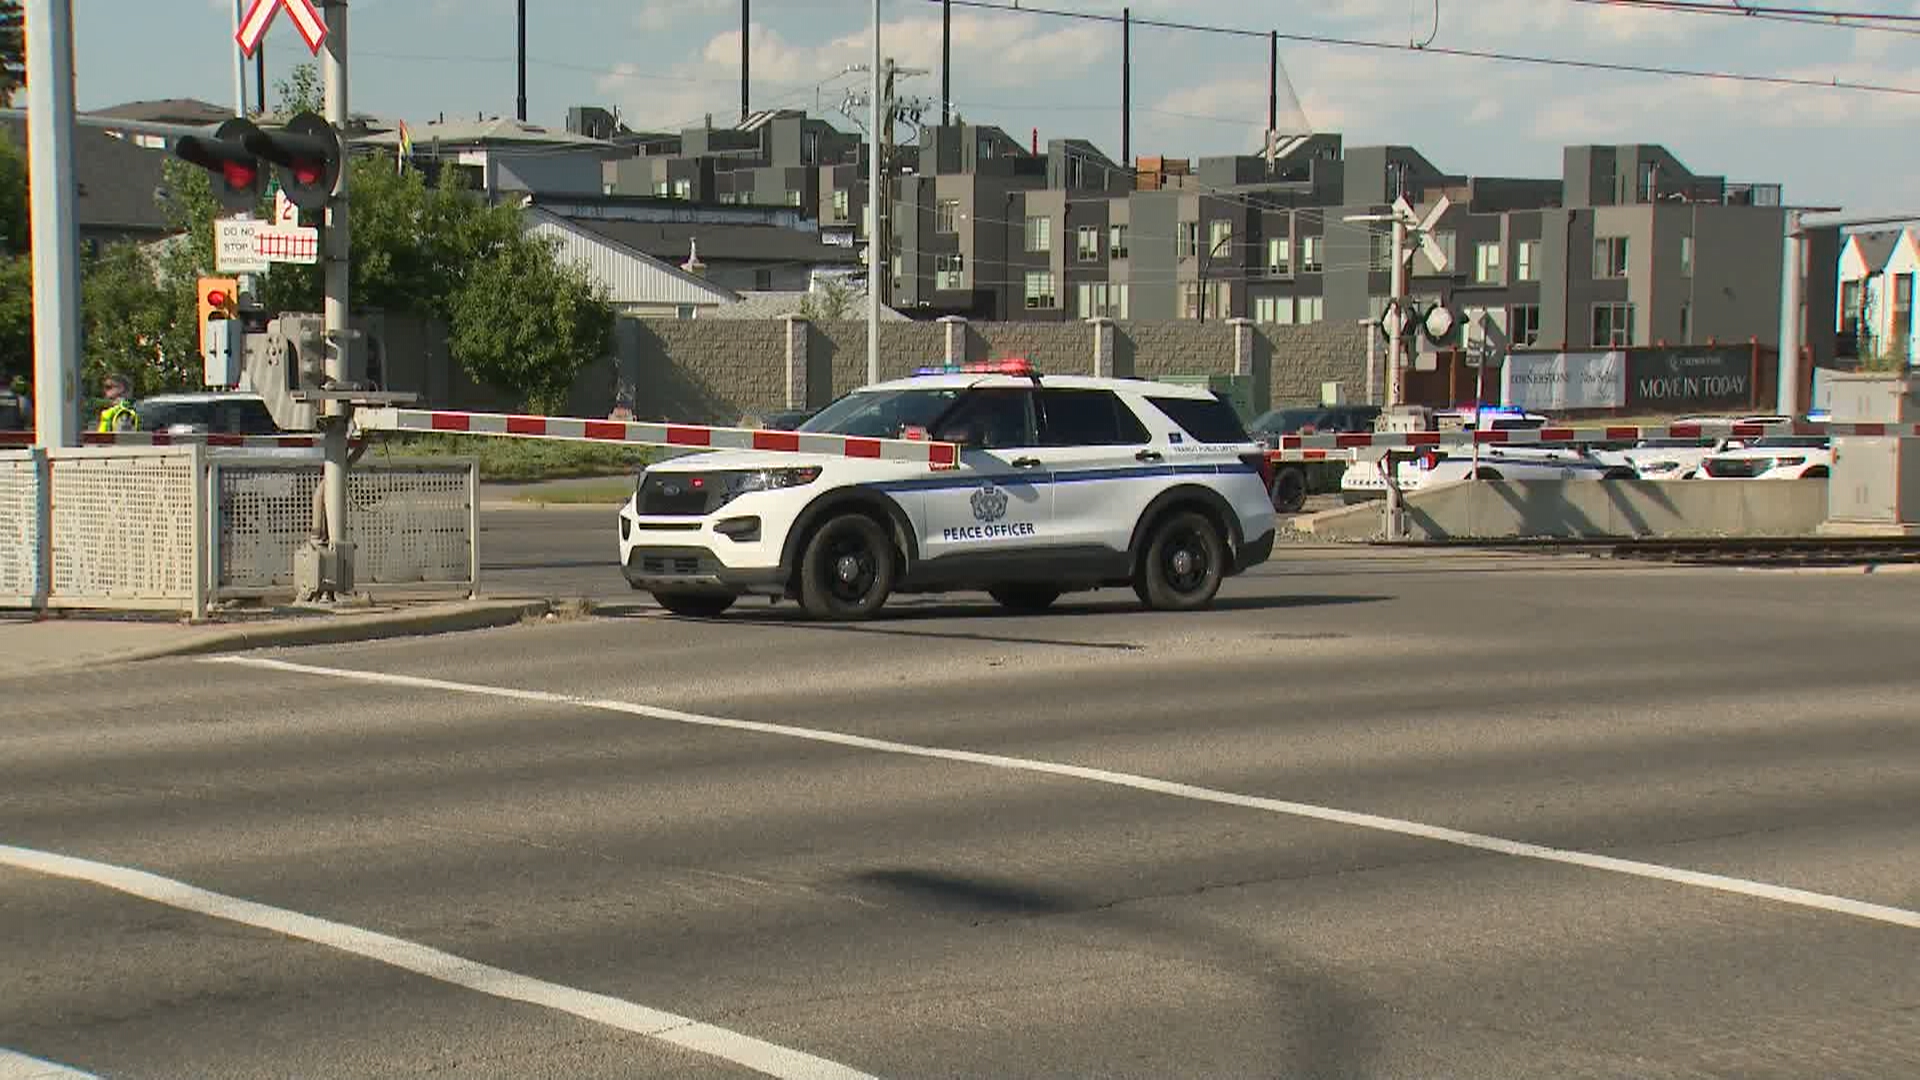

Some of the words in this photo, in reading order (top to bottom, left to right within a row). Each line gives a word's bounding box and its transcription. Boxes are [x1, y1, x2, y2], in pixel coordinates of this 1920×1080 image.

[283, 199, 292, 221] 2
[224, 227, 237, 236] DO
[241, 227, 255, 236] NO
[224, 243, 248, 251] STOP
[1639, 379, 1681, 398] MOVE
[1683, 378, 1698, 398] IN
[1702, 375, 1746, 396] TODAY
[944, 526, 981, 541] PEACE
[984, 523, 1035, 539] OFFICER
